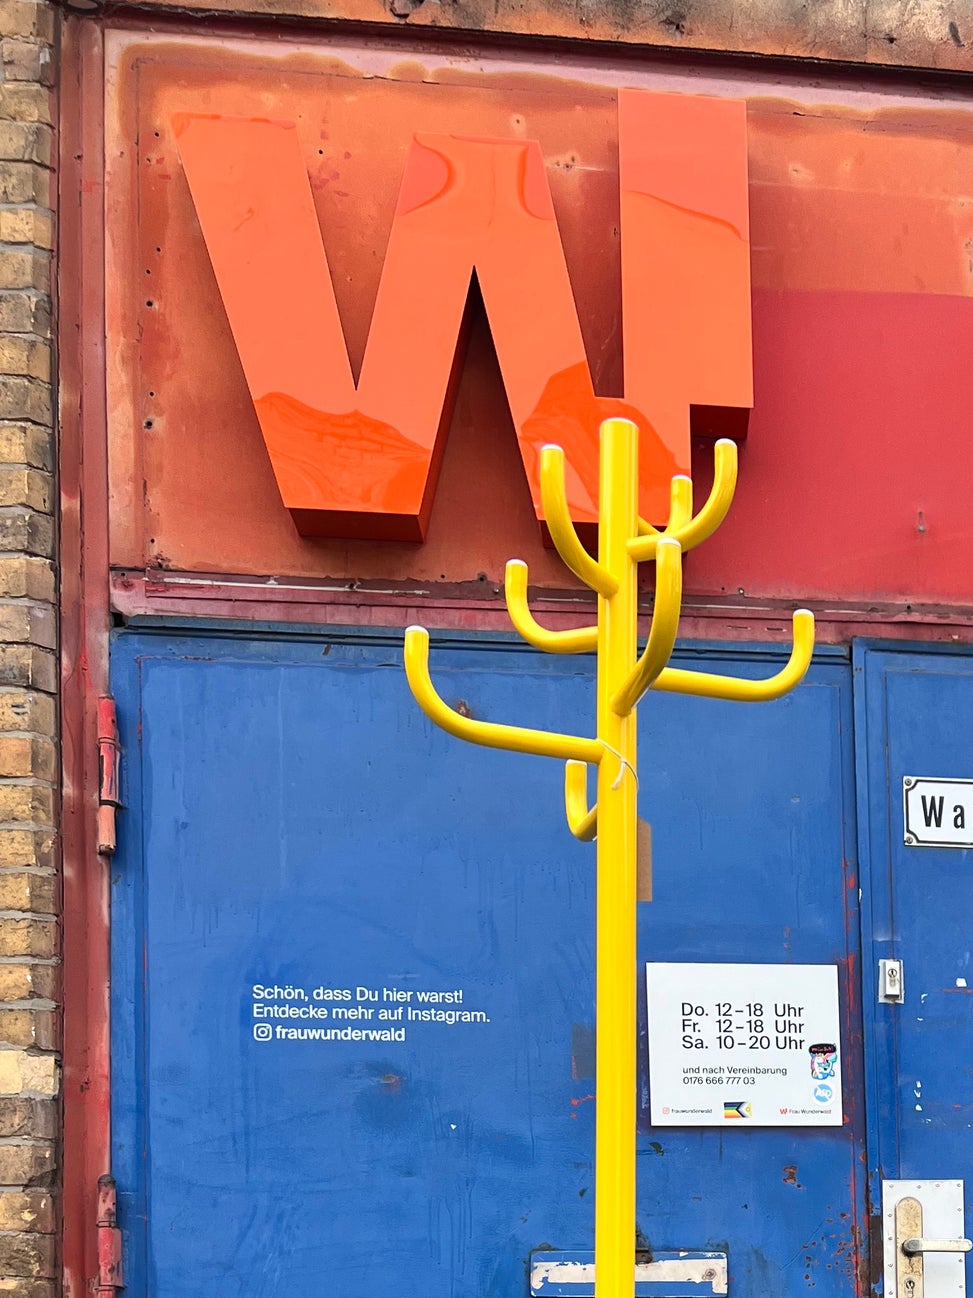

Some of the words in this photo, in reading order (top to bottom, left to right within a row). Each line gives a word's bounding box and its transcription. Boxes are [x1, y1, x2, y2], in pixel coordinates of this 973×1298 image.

[168, 87, 753, 540] W
[252, 985, 309, 1002] Schön,
[312, 986, 351, 1001] dass
[356, 987, 379, 1002] Du
[383, 987, 413, 1003] hier
[416, 989, 463, 1003] warst!
[253, 1003, 328, 1018] Entdecke
[332, 1005, 374, 1020] mehr
[378, 1006, 404, 1020] auf
[407, 1007, 491, 1024] Instagram.
[681, 1002, 709, 1017] Do.
[774, 1003, 804, 1017] Uhr
[275, 1025, 406, 1041] frauwunderwald
[682, 1019, 701, 1033] Fr.
[774, 1019, 805, 1033] Uhr
[682, 1035, 709, 1049] Sa.
[775, 1036, 805, 1050] Uhr
[682, 1066, 700, 1074] und
[702, 1066, 725, 1074] nach
[726, 1066, 787, 1076] Vereinbarung
[682, 1076, 703, 1085] 0176
[705, 1076, 724, 1085] 666
[725, 1077, 741, 1085] 777
[743, 1077, 755, 1085] 03
